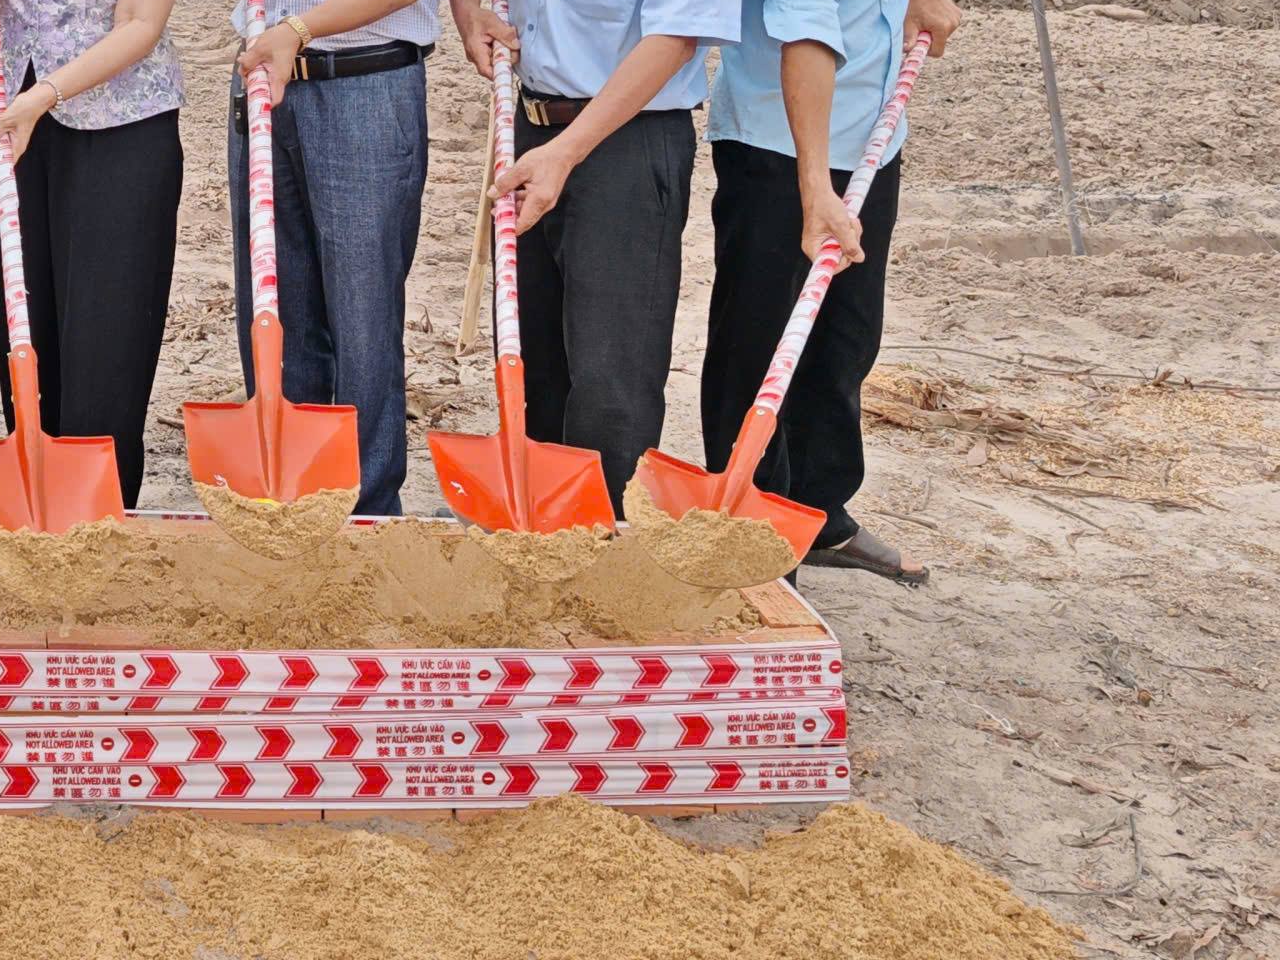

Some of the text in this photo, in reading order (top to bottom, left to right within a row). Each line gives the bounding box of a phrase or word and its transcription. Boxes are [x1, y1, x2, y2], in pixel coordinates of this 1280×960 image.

[402, 661, 417, 669] KHU
[47, 667, 62, 675] NOT
[63, 667, 95, 675] ALLOWED
[728, 722, 796, 732] NOT ALLOWED AREA
[377, 736, 390, 744] NOT
[392, 736, 424, 744] ALLOWED
[42, 741, 74, 749] ALLOWED
[809, 769, 828, 777] AREA
[68, 777, 100, 785] ALLOWED
